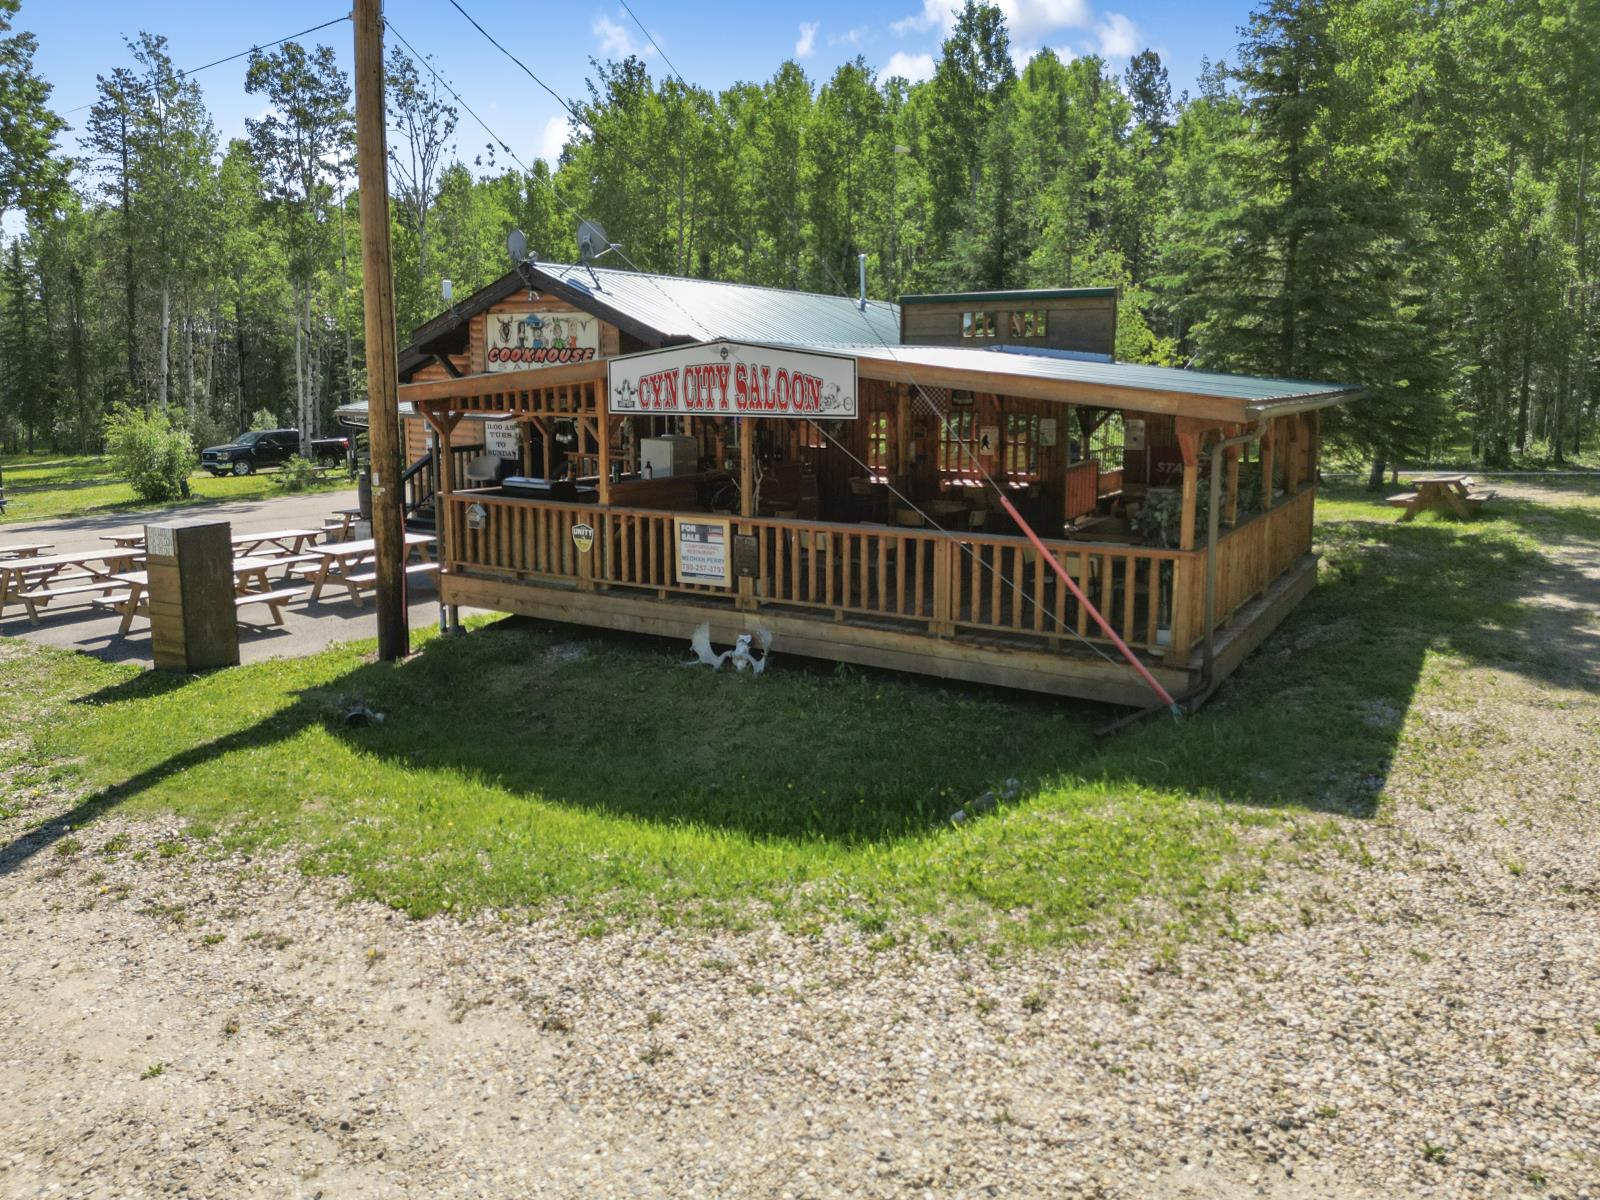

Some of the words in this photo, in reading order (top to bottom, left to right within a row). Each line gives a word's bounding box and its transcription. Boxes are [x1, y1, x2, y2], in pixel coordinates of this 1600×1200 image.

[488, 347, 596, 363] COOKHOUSE
[638, 368, 679, 410] CYN
[683, 362, 731, 410] CITY
[735, 362, 823, 412] SALOON
[574, 528, 592, 536] UNITY
[681, 524, 696, 533] FOR
[681, 533, 700, 541] SALE
